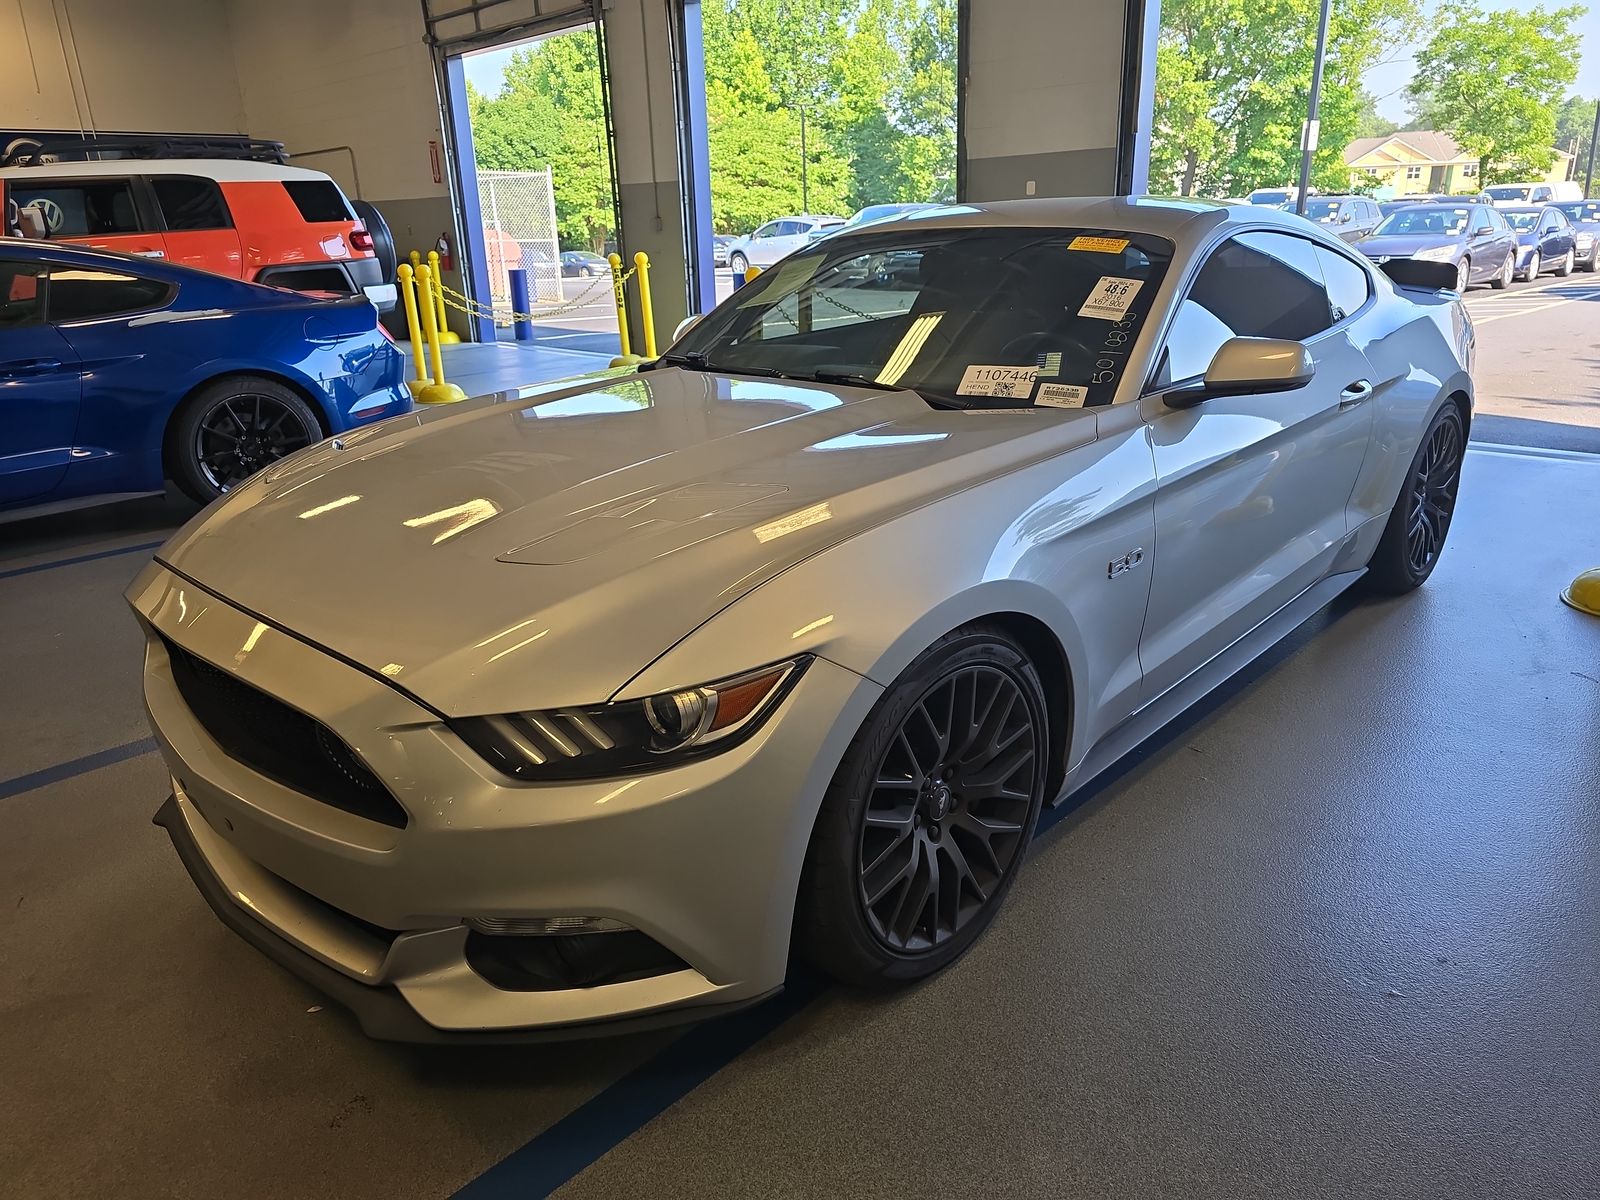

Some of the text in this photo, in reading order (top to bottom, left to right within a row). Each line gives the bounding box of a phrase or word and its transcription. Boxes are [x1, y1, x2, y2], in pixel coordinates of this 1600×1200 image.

[1104, 284, 1129, 295] 48:6
[1102, 293, 1123, 301] 2016
[975, 369, 1039, 383] 1107446
[1108, 547, 1144, 579] 5.0
